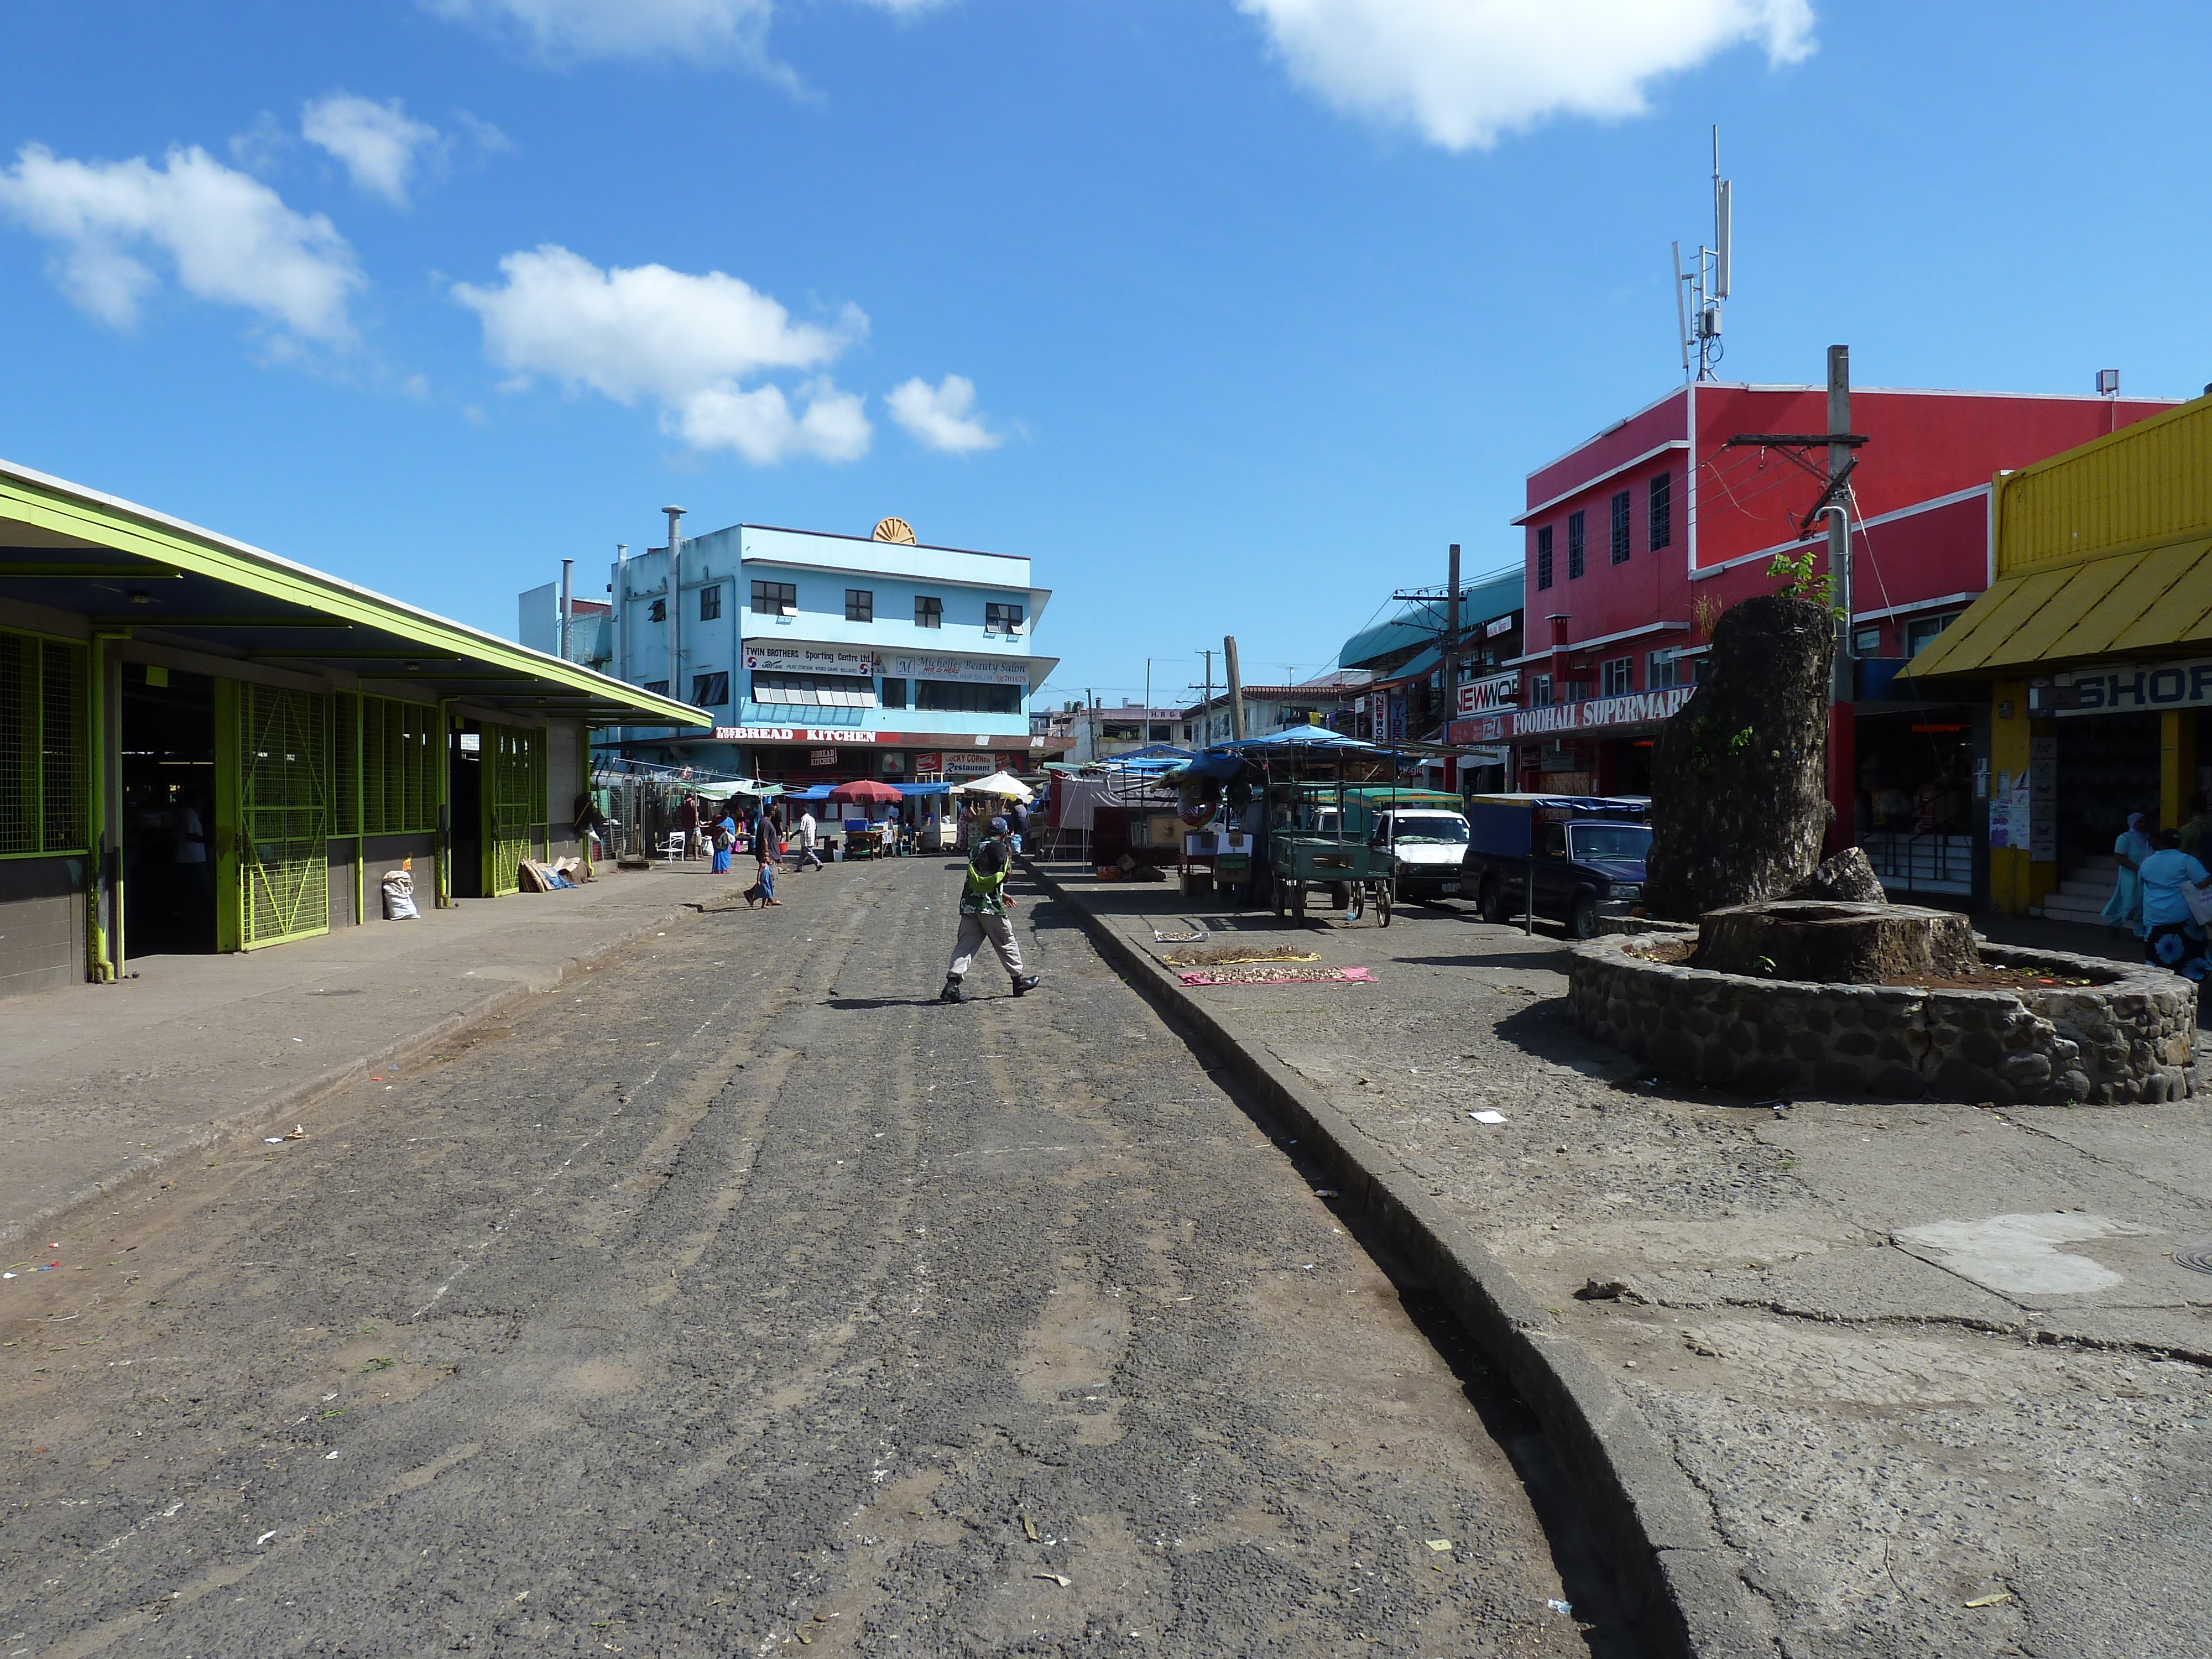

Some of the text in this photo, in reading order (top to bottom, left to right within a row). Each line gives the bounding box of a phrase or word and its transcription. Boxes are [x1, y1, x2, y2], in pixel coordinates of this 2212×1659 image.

[746, 647, 765, 656] TWIN
[767, 648, 799, 658] BROTHERS
[805, 650, 833, 662] Sporting
[838, 653, 858, 662] Centre
[917, 656, 1025, 674] Michelles Beauty Salon
[1512, 704, 1577, 735] FOODHALL
[735, 728, 877, 742] BREAD KITCHEN
[946, 754, 966, 763] LUCKY
[967, 754, 990, 763] CORNER
[946, 763, 990, 773] Restaurant
